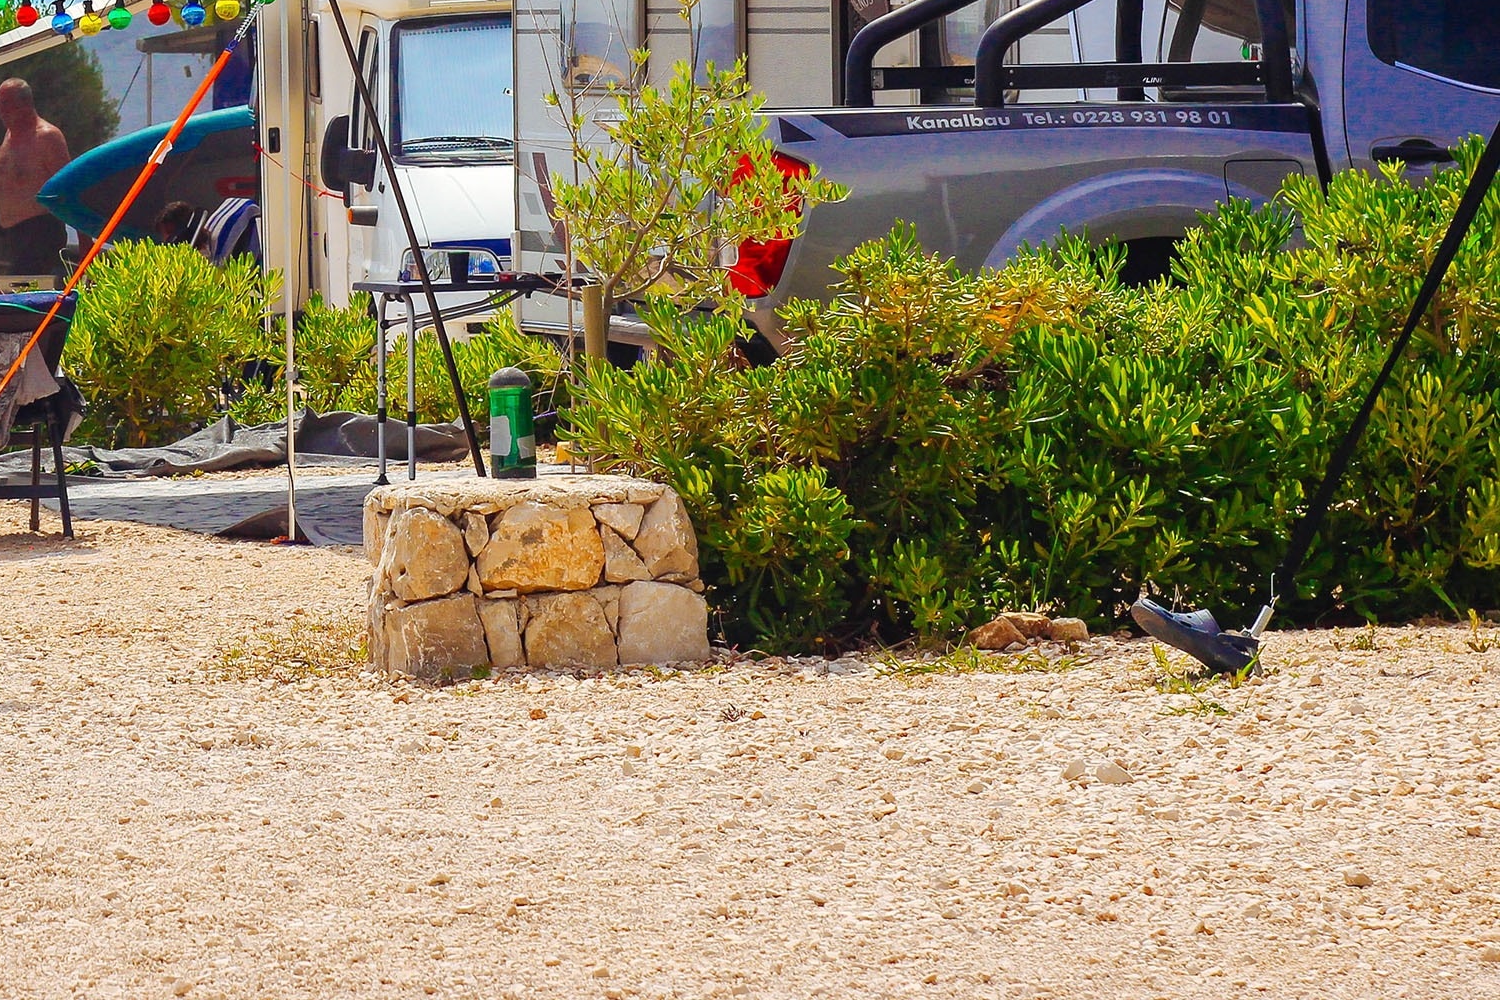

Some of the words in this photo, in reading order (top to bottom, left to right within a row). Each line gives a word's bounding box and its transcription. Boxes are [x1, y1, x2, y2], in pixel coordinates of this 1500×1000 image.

[906, 113, 1011, 130] Kanalbau
[1023, 112, 1066, 125] Tel.:
[1072, 111, 1125, 124] 0228
[1130, 111, 1168, 123] 931
[1175, 111, 1202, 123] 98
[1208, 111, 1232, 125] 01
